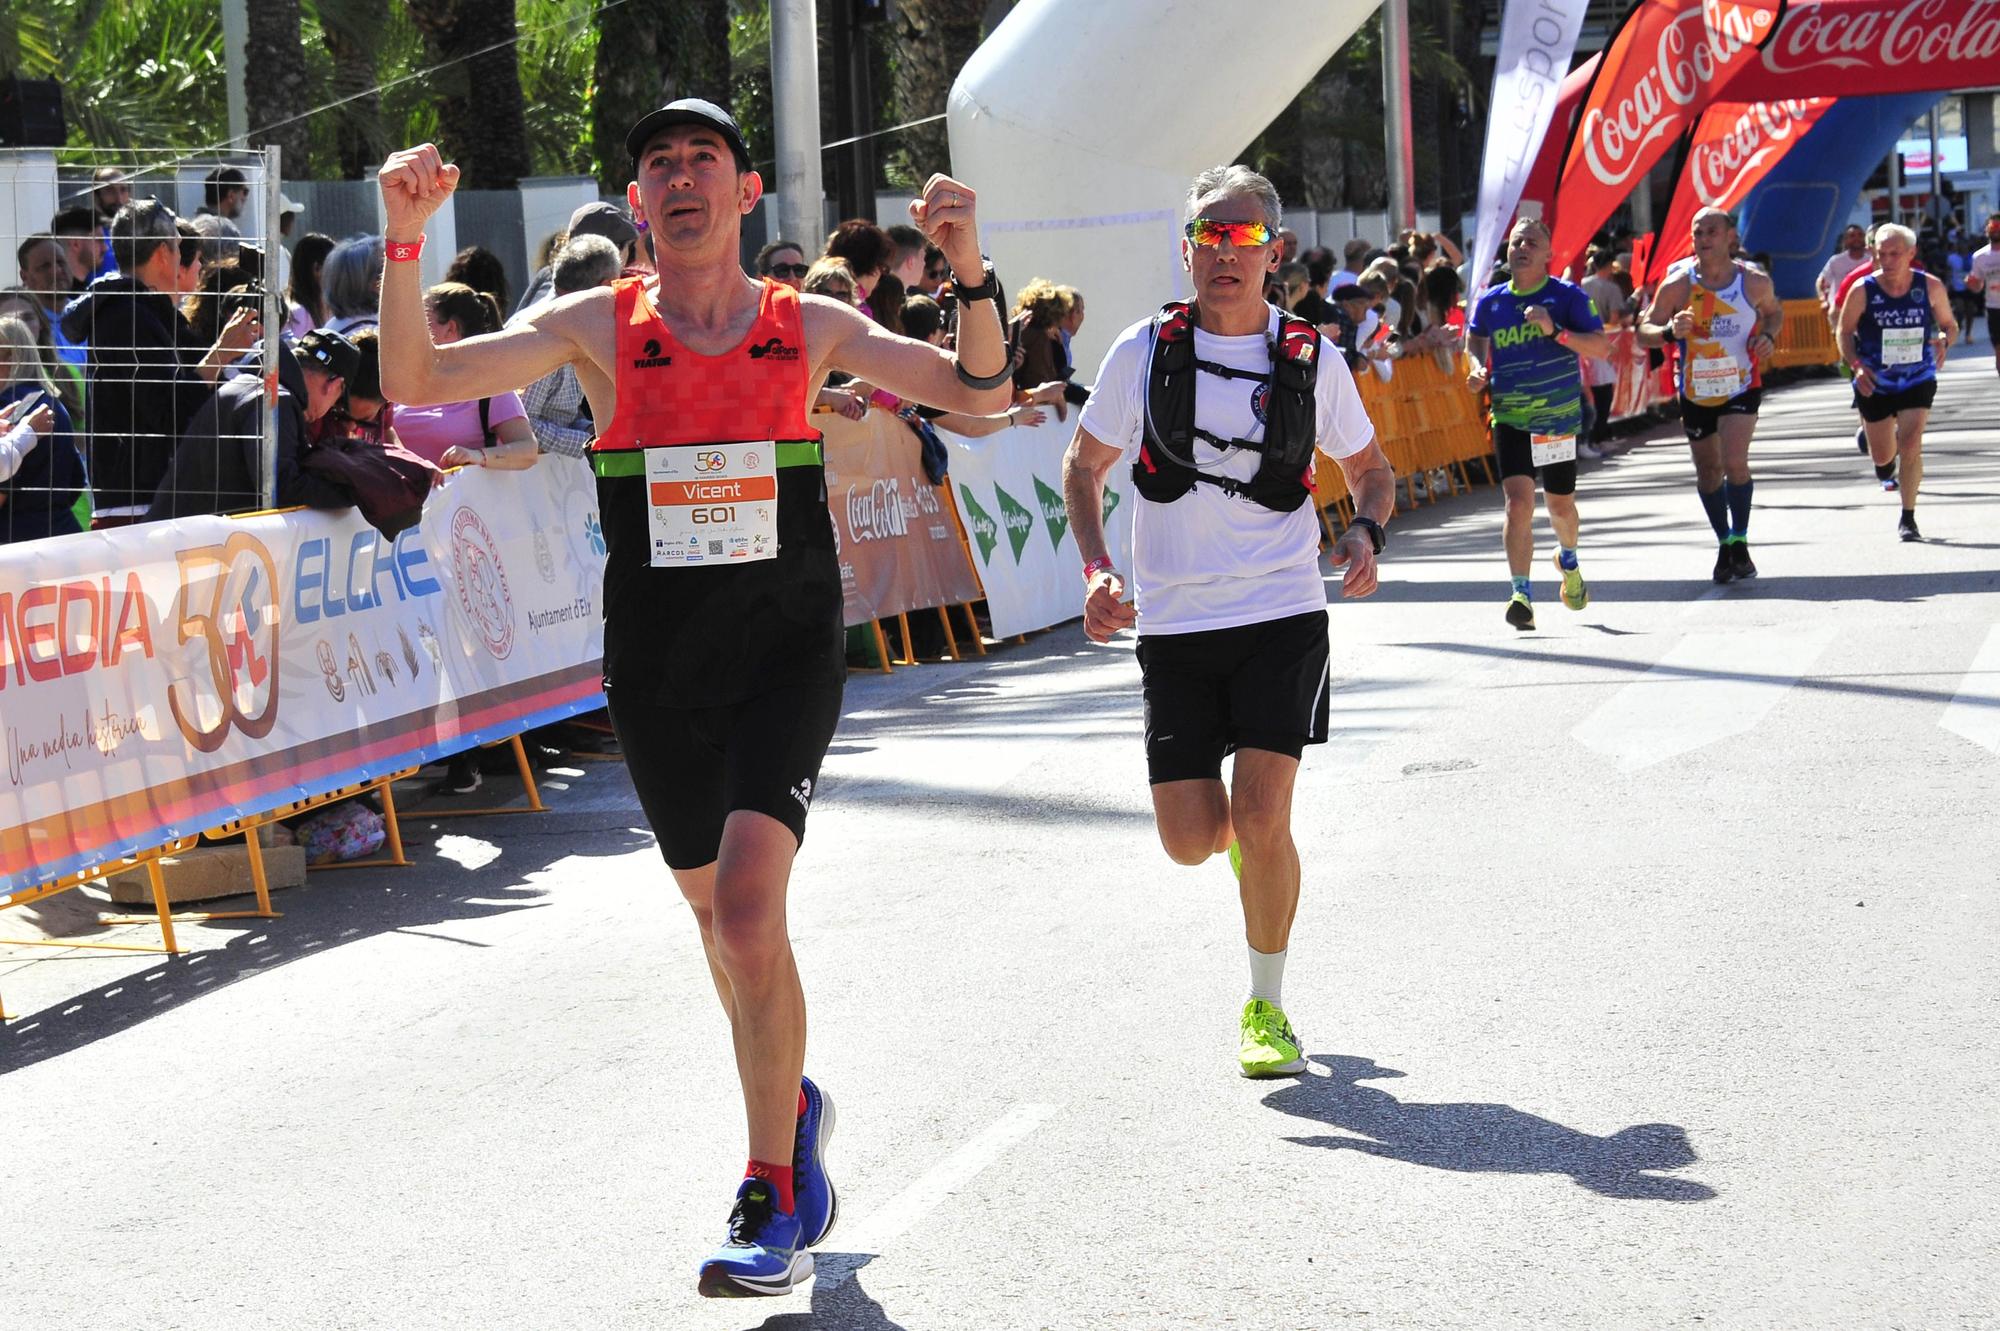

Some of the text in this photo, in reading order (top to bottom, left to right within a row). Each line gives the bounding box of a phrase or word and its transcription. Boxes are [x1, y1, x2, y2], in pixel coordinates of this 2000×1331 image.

[1762, 0, 2000, 74] Coca-Cola
[1583, 0, 1753, 185] Coca-Cola
[633, 356, 672, 369] VIATOR
[682, 481, 742, 500] Vicent
[691, 506, 736, 524] 601
[168, 531, 280, 753] 50
[295, 522, 441, 624] ELCHE
[528, 597, 592, 635] Ajuntament d'Elx
[7, 726, 40, 786] Una
[42, 712, 84, 770] media
